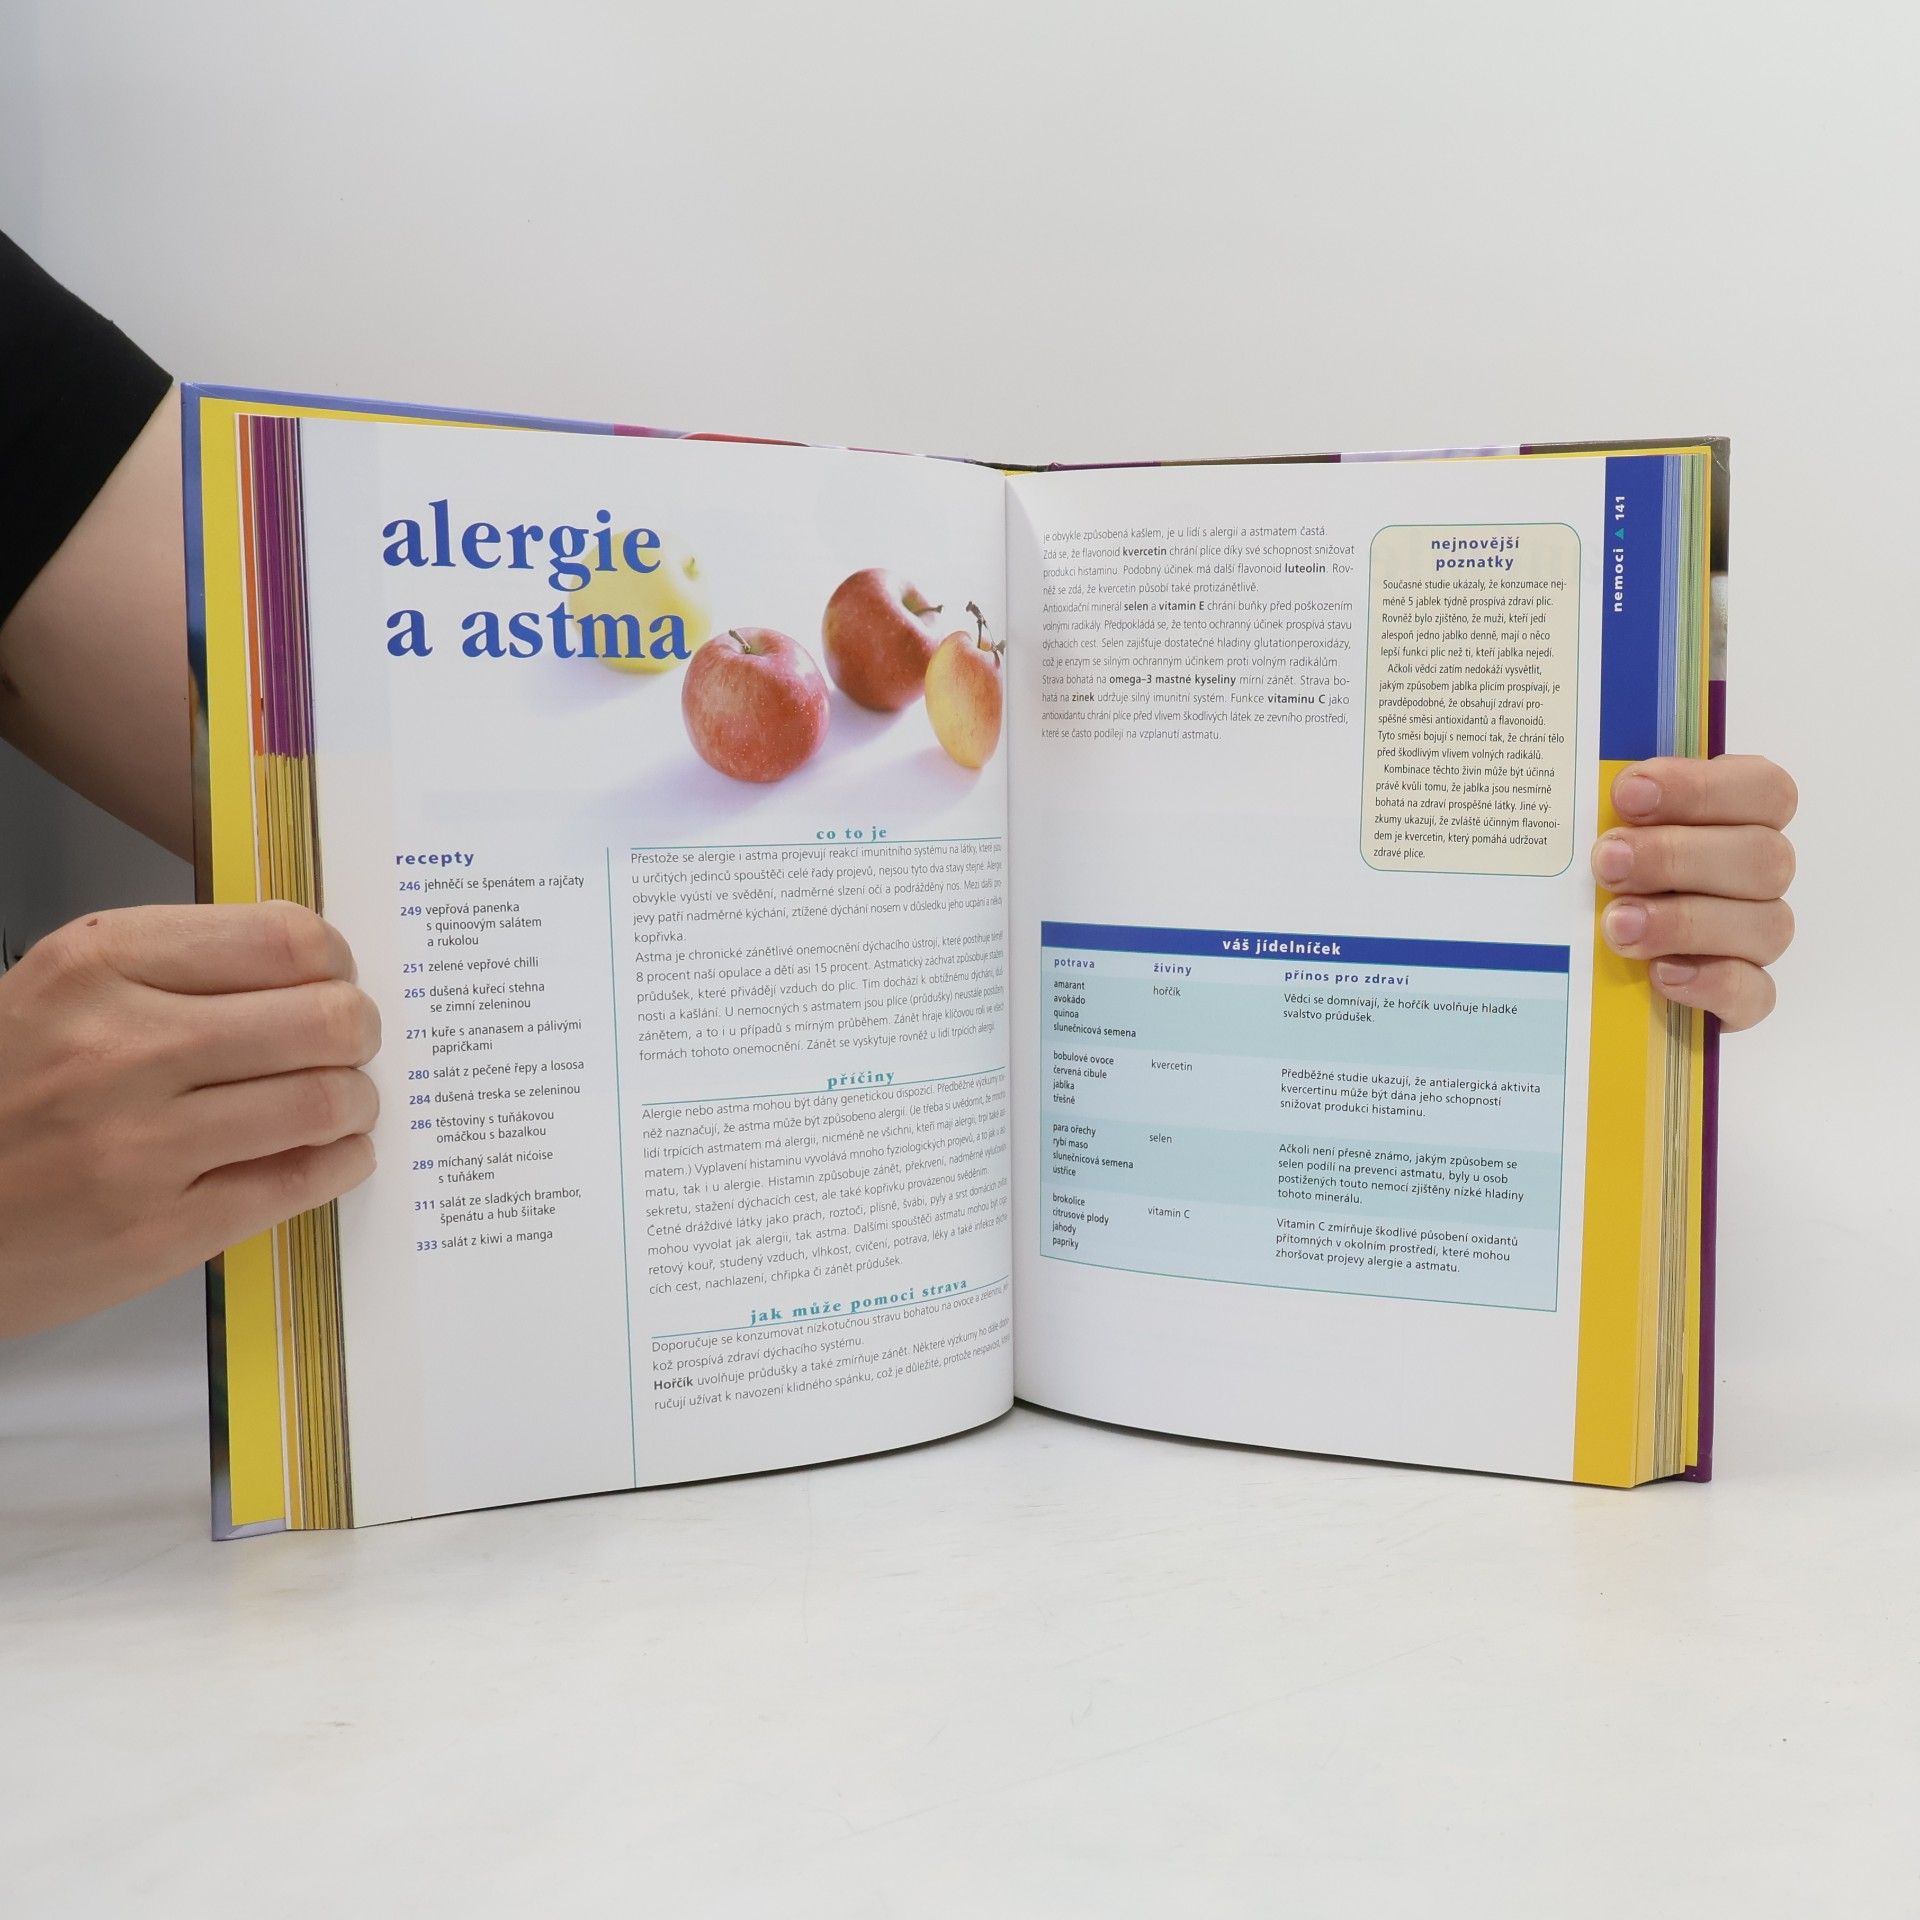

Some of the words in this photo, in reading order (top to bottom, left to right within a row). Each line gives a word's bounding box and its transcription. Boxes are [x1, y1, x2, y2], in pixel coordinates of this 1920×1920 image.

[1614, 496, 1625, 520] 141
[382, 498, 662, 592] alergie
[1082, 546, 1121, 558] flavonoid
[1122, 545, 1167, 557] kvercetin
[1168, 545, 1199, 556] chrání
[1262, 544, 1313, 557] schopnost
[1314, 544, 1355, 555] snižovat
[1431, 536, 1520, 553] nejnovější
[1284, 562, 1329, 574] luteolin.
[1332, 563, 1354, 574] Rov-
[1436, 554, 1514, 572] poznatky
[1382, 579, 1423, 590] Současné
[1424, 578, 1451, 590] studie
[1452, 578, 1486, 592] ukázaly,
[1500, 578, 1549, 589] konzumace
[1550, 580, 1567, 592] nej-
[1612, 548, 1624, 612] nemoci
[1381, 612, 1413, 623] Rovněž
[1414, 612, 1433, 626] bylo
[1434, 612, 1469, 626] zjištěno,
[1508, 612, 1529, 624] kteří
[1529, 612, 1546, 626] jedí
[386, 609, 434, 658] a
[461, 601, 692, 660] astma
[1109, 674, 1152, 687] omega–3
[1155, 674, 1192, 684] mastné
[1194, 674, 1237, 687] kyseliny
[1383, 763, 1431, 775] Kombinace
[1432, 764, 1460, 776] těchto
[1461, 765, 1482, 776] živin
[1484, 765, 1508, 777] může
[1509, 766, 1524, 779] být
[1526, 766, 1555, 778] účinná
[816, 830, 836, 839] co
[845, 828, 863, 839] to
[872, 825, 887, 841] je
[395, 851, 475, 868] recepty
[1373, 846, 1402, 858] zdravé
[399, 880, 421, 892] 246
[424, 877, 464, 894] jehněčí
[466, 880, 479, 889] se
[482, 876, 536, 891] špenátem
[538, 878, 546, 887] a
[548, 875, 585, 889] rajčaty
[634, 930, 687, 945] kopřivka.
[1222, 938, 1250, 951] váš
[1255, 938, 1341, 956] jídelníček
[402, 962, 424, 974] 251
[428, 959, 464, 972] zelené
[466, 957, 511, 973] vepřové
[513, 956, 539, 969] chilli
[1053, 957, 1095, 969] potrava
[1153, 962, 1192, 977] živiny
[1053, 980, 1085, 991] amarant
[1284, 969, 1330, 982] přínos
[1335, 974, 1359, 985] pro
[1364, 973, 1409, 986] zdraví
[404, 987, 426, 999] 265
[429, 984, 470, 997] dušená
[472, 982, 506, 995] kuřecí
[508, 981, 545, 994] stehna
[1153, 985, 1182, 997] hořčík
[430, 1003, 443, 1013] se
[445, 999, 476, 1012] zimní
[478, 997, 531, 1011] zeleninou
[1053, 994, 1086, 1005] avokádo
[1283, 993, 1311, 1004] Vědci
[1313, 996, 1325, 1005] se
[1326, 994, 1380, 1010] domnívají,
[1398, 998, 1430, 1010] hořčík
[1433, 1001, 1479, 1015] uvolňuje
[1481, 1002, 1518, 1015] hladké
[1053, 1009, 1079, 1019] quinoa
[1283, 1008, 1323, 1020] svalstvo
[1324, 1010, 1375, 1023] průdušek.
[432, 1039, 493, 1057] papričkami
[1151, 1058, 1193, 1072] kvercetin
[827, 1071, 894, 1089] příčiny
[1281, 1068, 1335, 1081] Předběžné
[1337, 1072, 1369, 1083] studie
[1371, 1073, 1411, 1088] ukazují,
[1429, 1077, 1498, 1092] antialergická
[1500, 1081, 1541, 1094] aktivita
[409, 1094, 431, 1106] 284
[434, 1089, 475, 1103] dušená
[477, 1087, 511, 1101] treska
[513, 1089, 526, 1098] se
[528, 1084, 581, 1097] zeleninou
[1280, 1098, 1322, 1111] snižovat
[1324, 1102, 1369, 1114] produkci
[1371, 1103, 1426, 1117] histaminu.
[410, 1118, 433, 1130] 286
[435, 1114, 486, 1128] těstoviny
[488, 1115, 495, 1124] s
[497, 1110, 554, 1124] tuňákovou
[436, 1129, 486, 1144] omáčkou
[489, 1131, 495, 1140] s
[498, 1125, 547, 1139] bazalkou
[1149, 1132, 1173, 1144] selen
[1052, 1192, 1086, 1207] brokolice
[1277, 1188, 1312, 1200] tohoto
[1314, 1191, 1363, 1204] minerálu.
[1147, 1207, 1181, 1218] vitamin
[1183, 1209, 1191, 1219] C
[416, 1239, 438, 1252] 333
[441, 1235, 469, 1249] salát
[471, 1237, 477, 1246] z
[480, 1232, 503, 1245] kiwi
[506, 1234, 513, 1243] a
[516, 1230, 553, 1243] manga
[1275, 1247, 1324, 1262] zhoršovat
[1326, 1253, 1365, 1267] projevy
[1367, 1255, 1403, 1270] alergie
[1405, 1260, 1412, 1269] a
[1414, 1260, 1460, 1273] astmatu.
[649, 1282, 672, 1295] cích
[675, 1280, 701, 1292] cest,
[705, 1272, 767, 1289] nachlazení,
[770, 1267, 810, 1282] chřipka
[824, 1262, 853, 1276] zánět
[855, 1254, 903, 1274] průdušek.
[750, 1307, 782, 1325] jak
[792, 1301, 842, 1317] může
[850, 1288, 915, 1313] pomoci
[921, 1279, 967, 1297] strava
[652, 1359, 674, 1372] kož
[676, 1353, 724, 1372] prospívá
[727, 1348, 760, 1364] zdraví
[762, 1342, 818, 1361] dýchacího
[820, 1336, 865, 1353] systému.
[653, 1375, 694, 1391] Hořčík
[697, 1370, 745, 1386] uvolňuje
[748, 1363, 798, 1382] průdušky
[800, 1364, 808, 1373] a
[810, 1358, 833, 1372] také
[836, 1353, 880, 1368] zmírňuje
